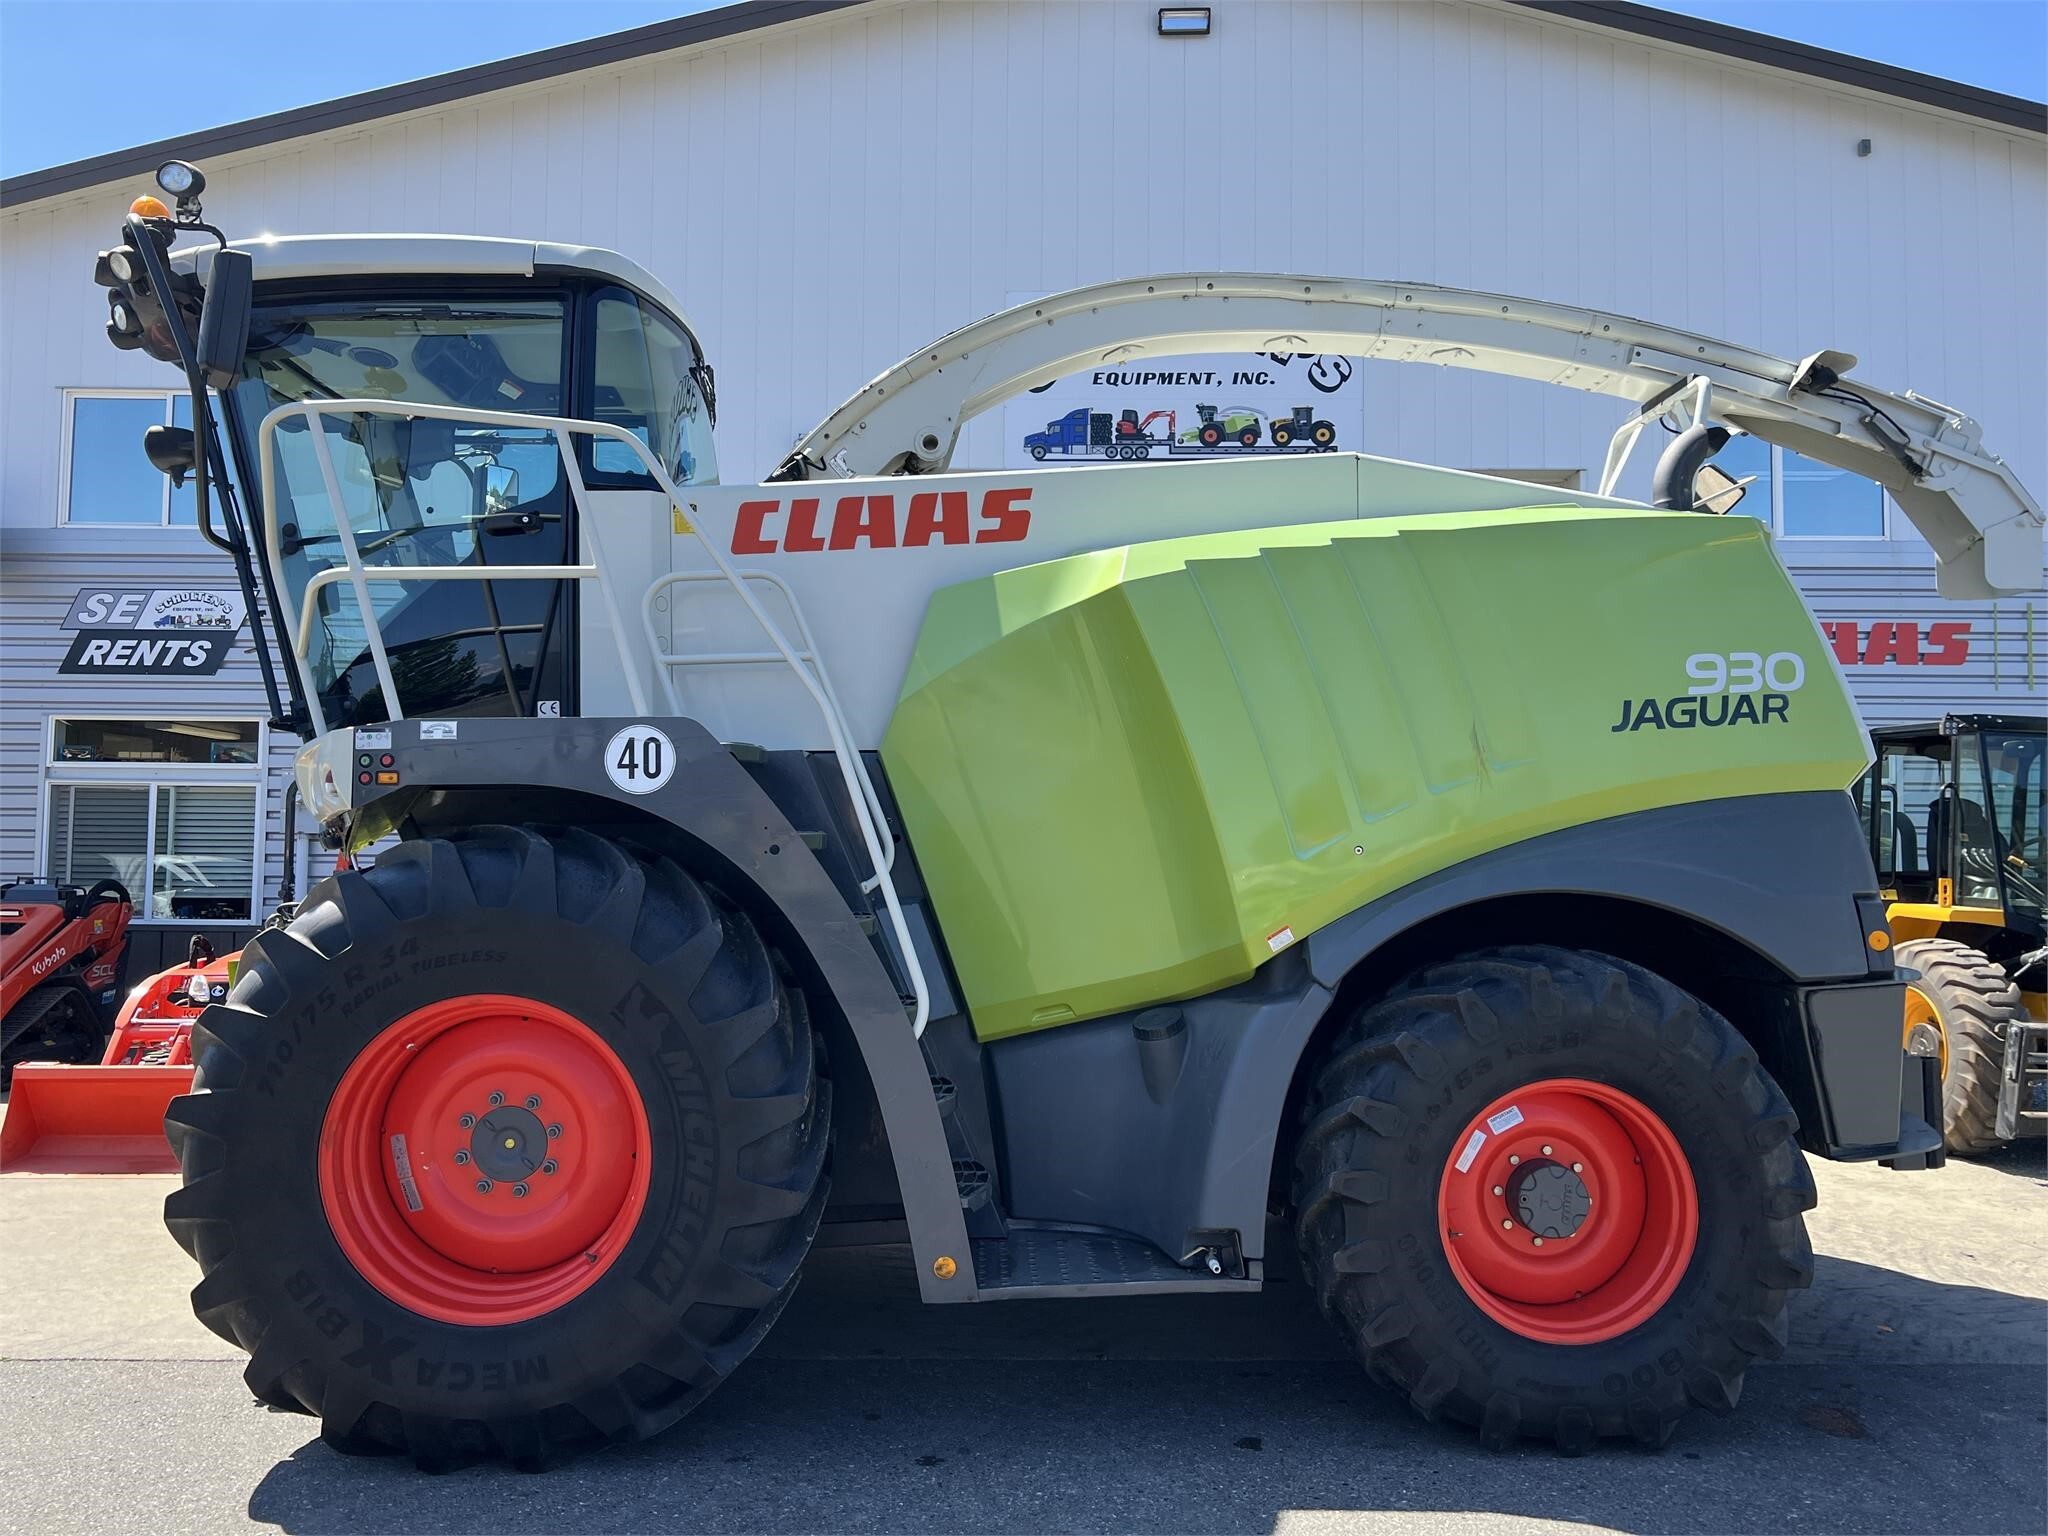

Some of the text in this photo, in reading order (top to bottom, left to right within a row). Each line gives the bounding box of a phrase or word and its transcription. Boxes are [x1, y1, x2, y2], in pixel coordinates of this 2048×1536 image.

[1092, 372, 1276, 388] EQUIPMENT, INC.
[730, 487, 1034, 555] CLAAS
[77, 593, 148, 625] SE
[154, 591, 233, 615] SCHOLTEN'S
[77, 639, 212, 667] RENTS
[1820, 622, 1972, 665] AAS
[1685, 651, 1805, 694] 930
[1610, 693, 1789, 733] JAGUAR
[617, 736, 662, 779] 40
[31, 946, 66, 976] Kubota
[91, 964, 114, 977] SCL
[411, 949, 509, 976] TUBELESS
[652, 1048, 716, 1297] MICHELIN
